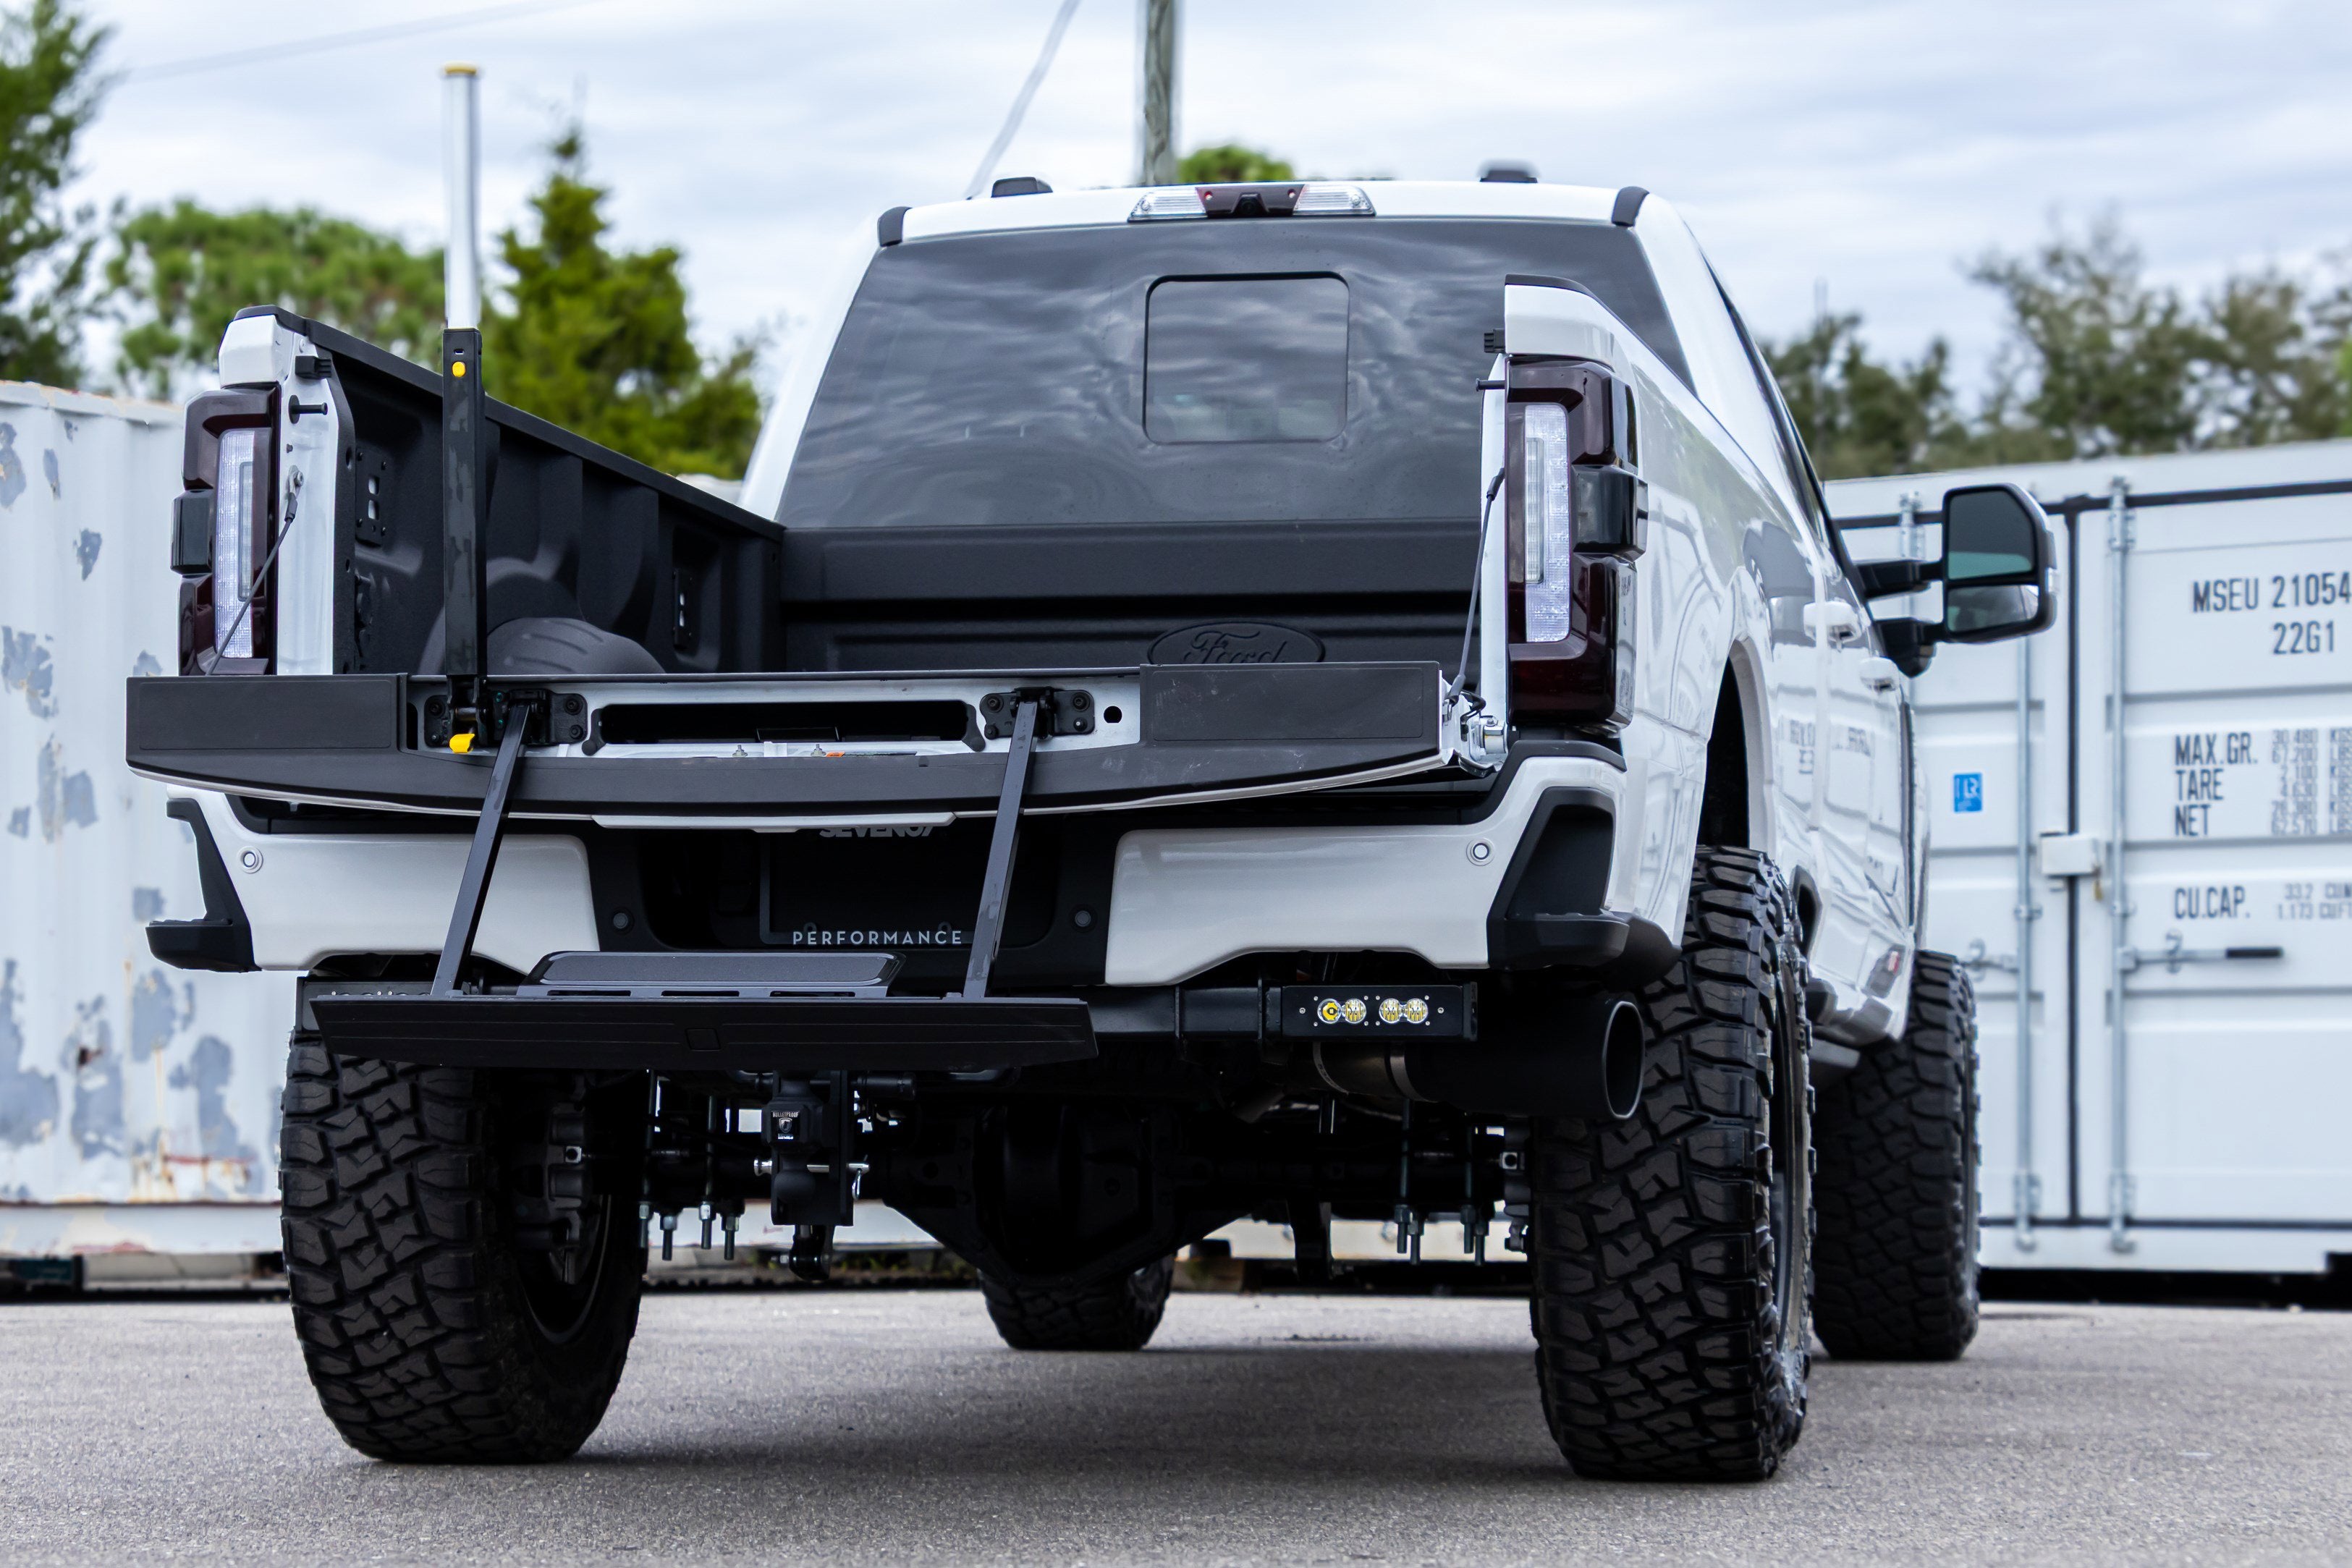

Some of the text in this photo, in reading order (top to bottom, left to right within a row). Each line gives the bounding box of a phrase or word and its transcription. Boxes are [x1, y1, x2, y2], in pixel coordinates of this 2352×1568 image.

[2193, 578, 2259, 614] MSEU
[2272, 619, 2335, 655] 22G1
[2175, 768, 2224, 801] TARE
[2175, 804, 2211, 836] NET
[792, 931, 962, 945] PERFORMANCE
